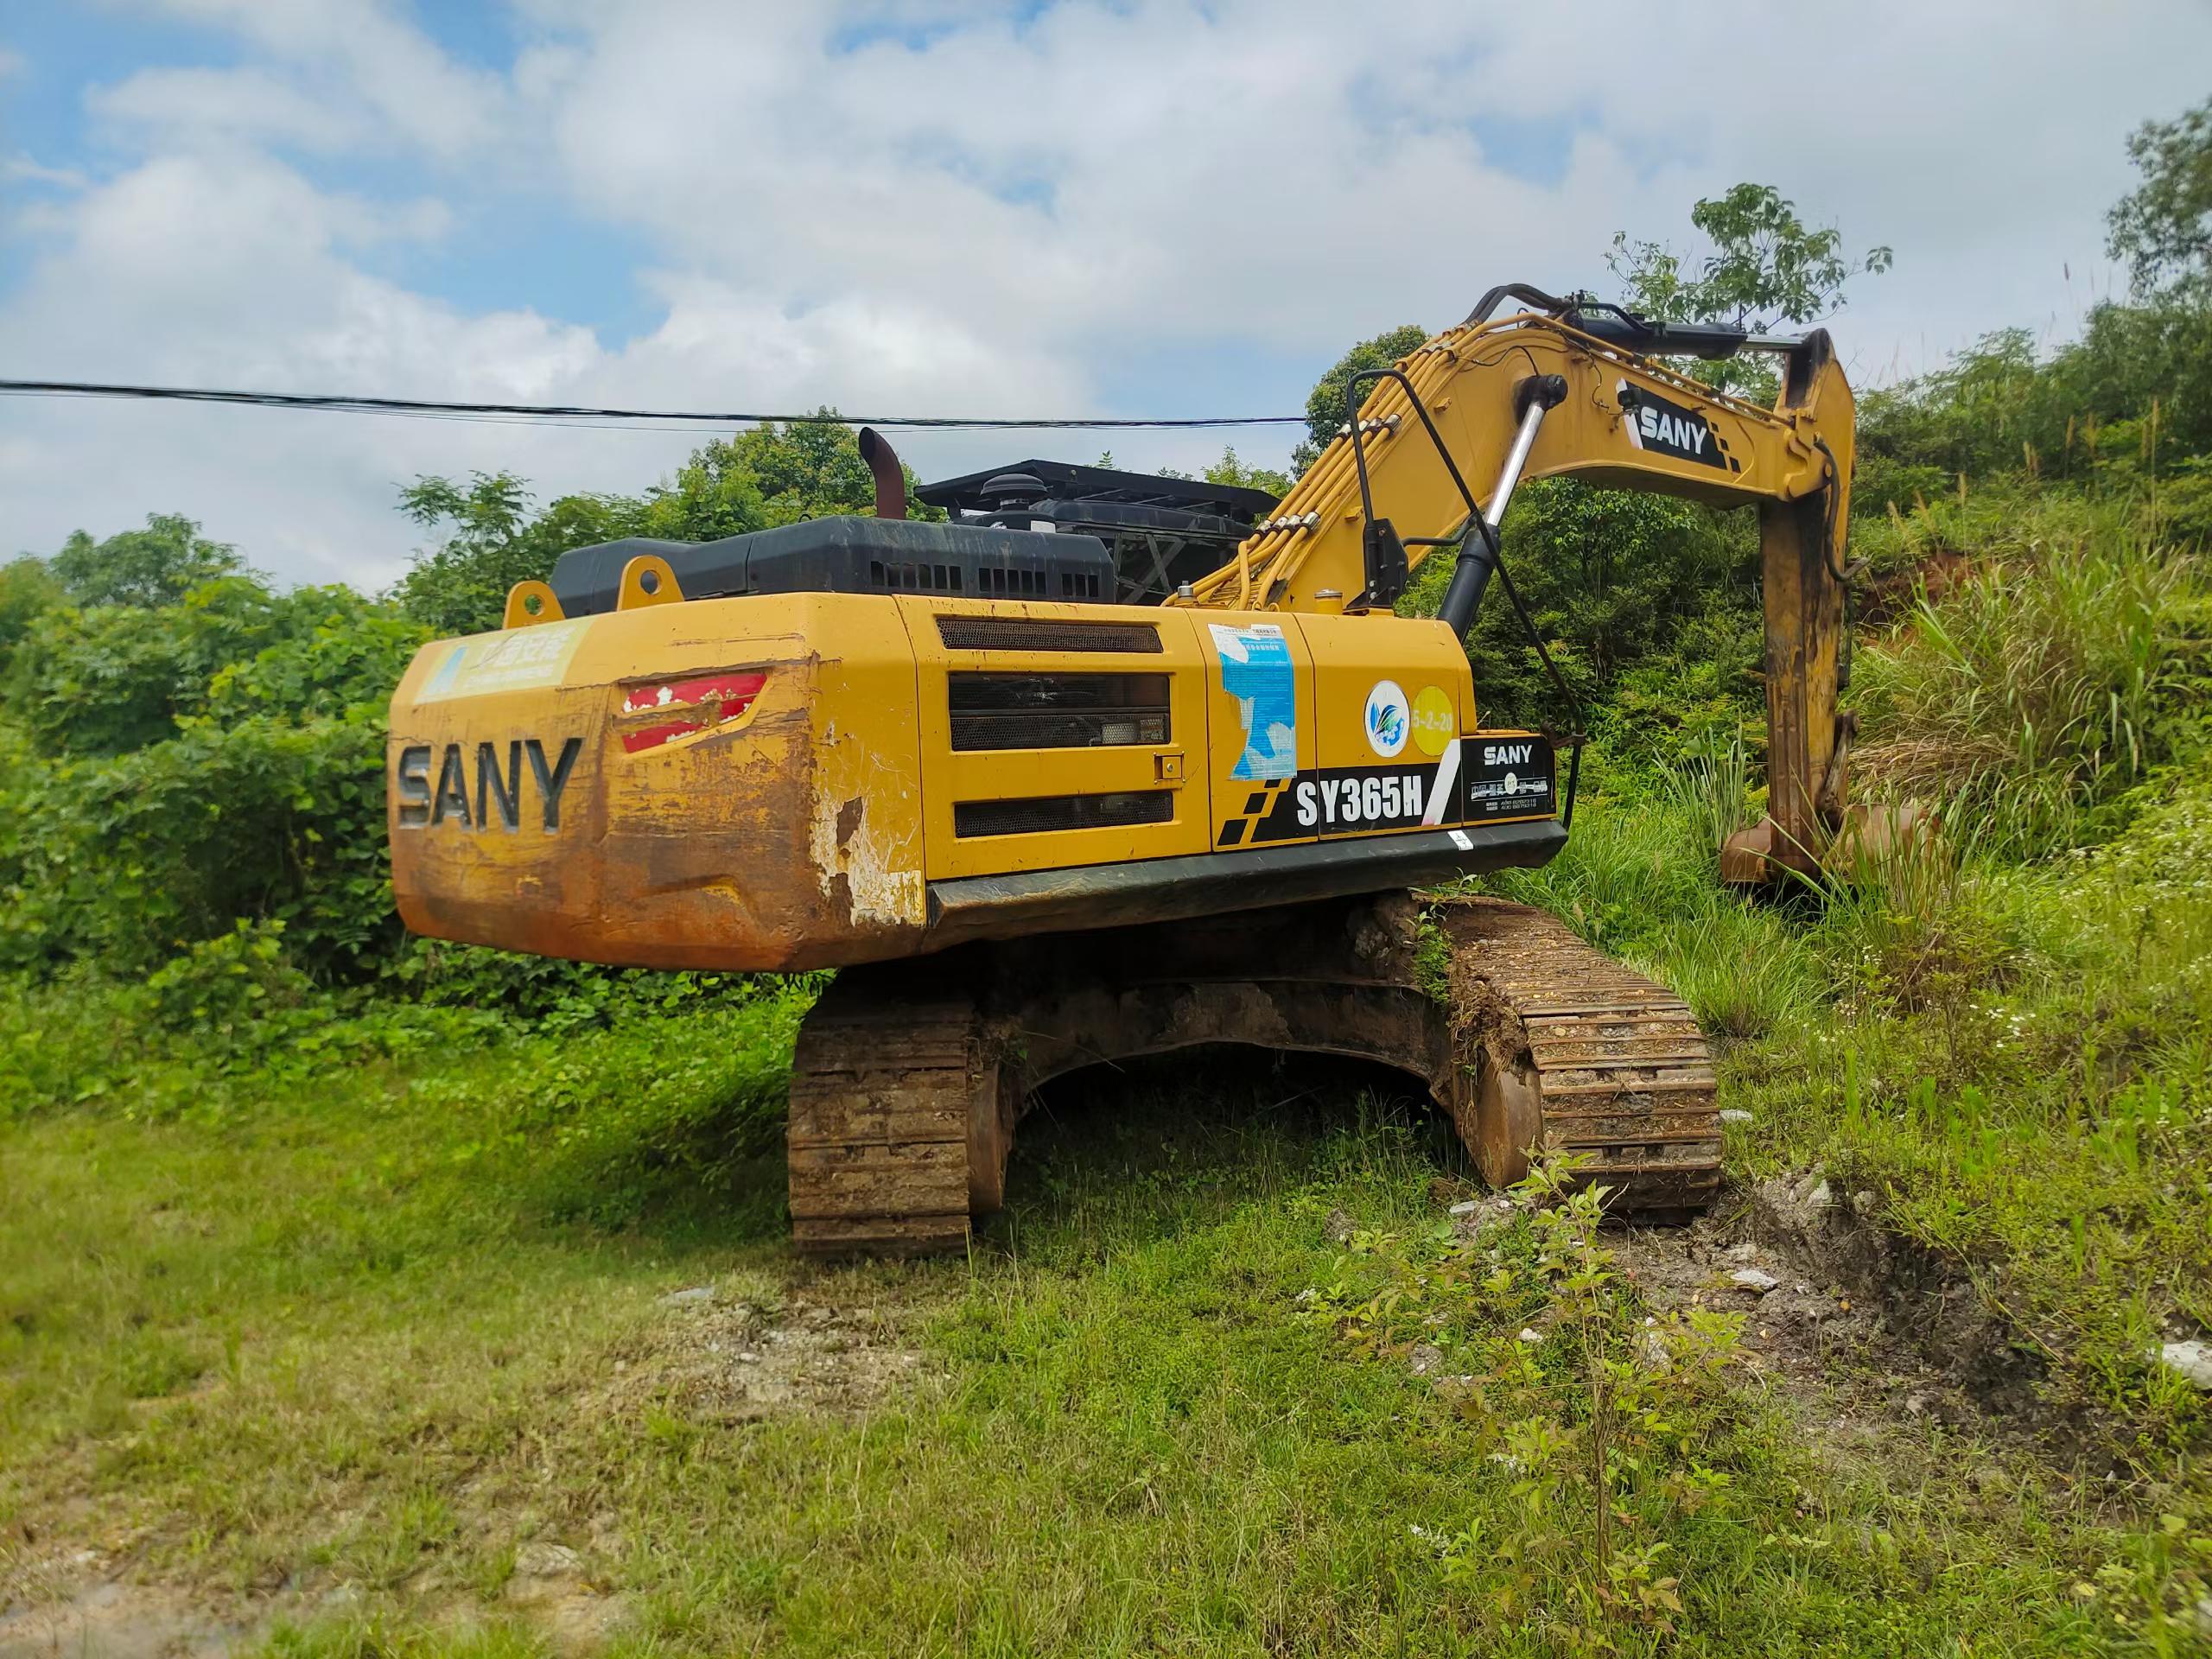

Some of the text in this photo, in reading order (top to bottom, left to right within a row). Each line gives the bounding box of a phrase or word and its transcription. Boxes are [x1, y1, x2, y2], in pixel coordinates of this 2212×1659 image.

[1640, 406, 1707, 454] SANY
[1484, 745, 1533, 766] SANY
[399, 738, 582, 833] SANY
[1296, 775, 1422, 827] SY365H
